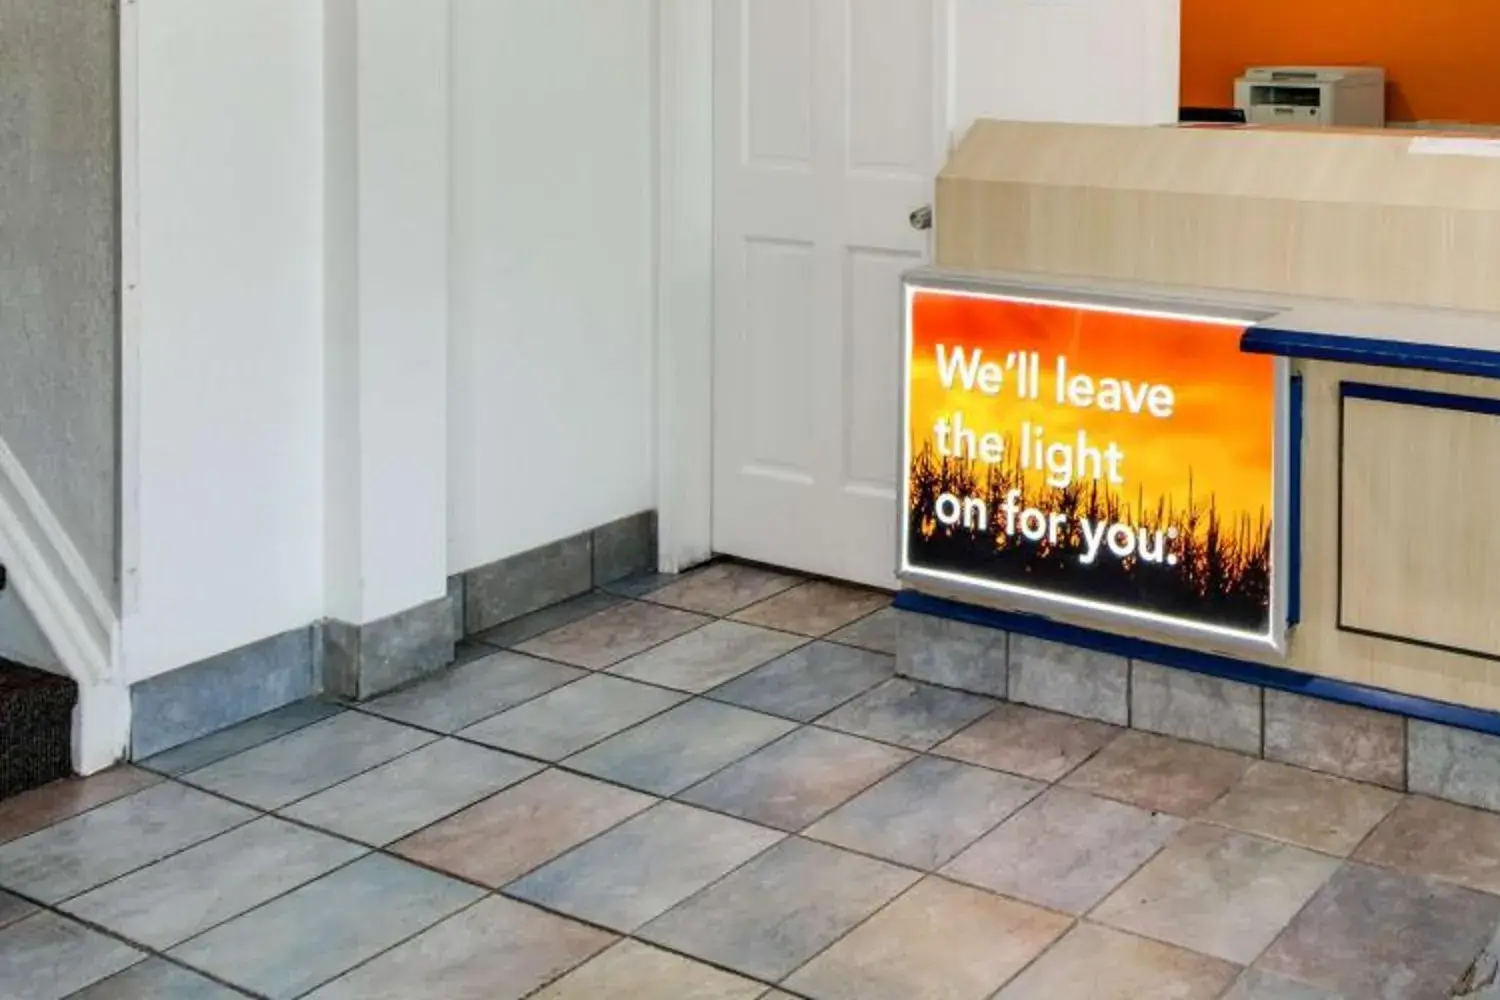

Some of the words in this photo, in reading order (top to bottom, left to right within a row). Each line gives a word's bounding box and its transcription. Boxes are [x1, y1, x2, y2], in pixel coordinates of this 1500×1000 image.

[935, 343, 1039, 399] We'll
[1056, 355, 1175, 418] leave
[933, 413, 1005, 465] the
[1020, 421, 1124, 487] light
[935, 492, 987, 531] on
[1002, 488, 1068, 546] for
